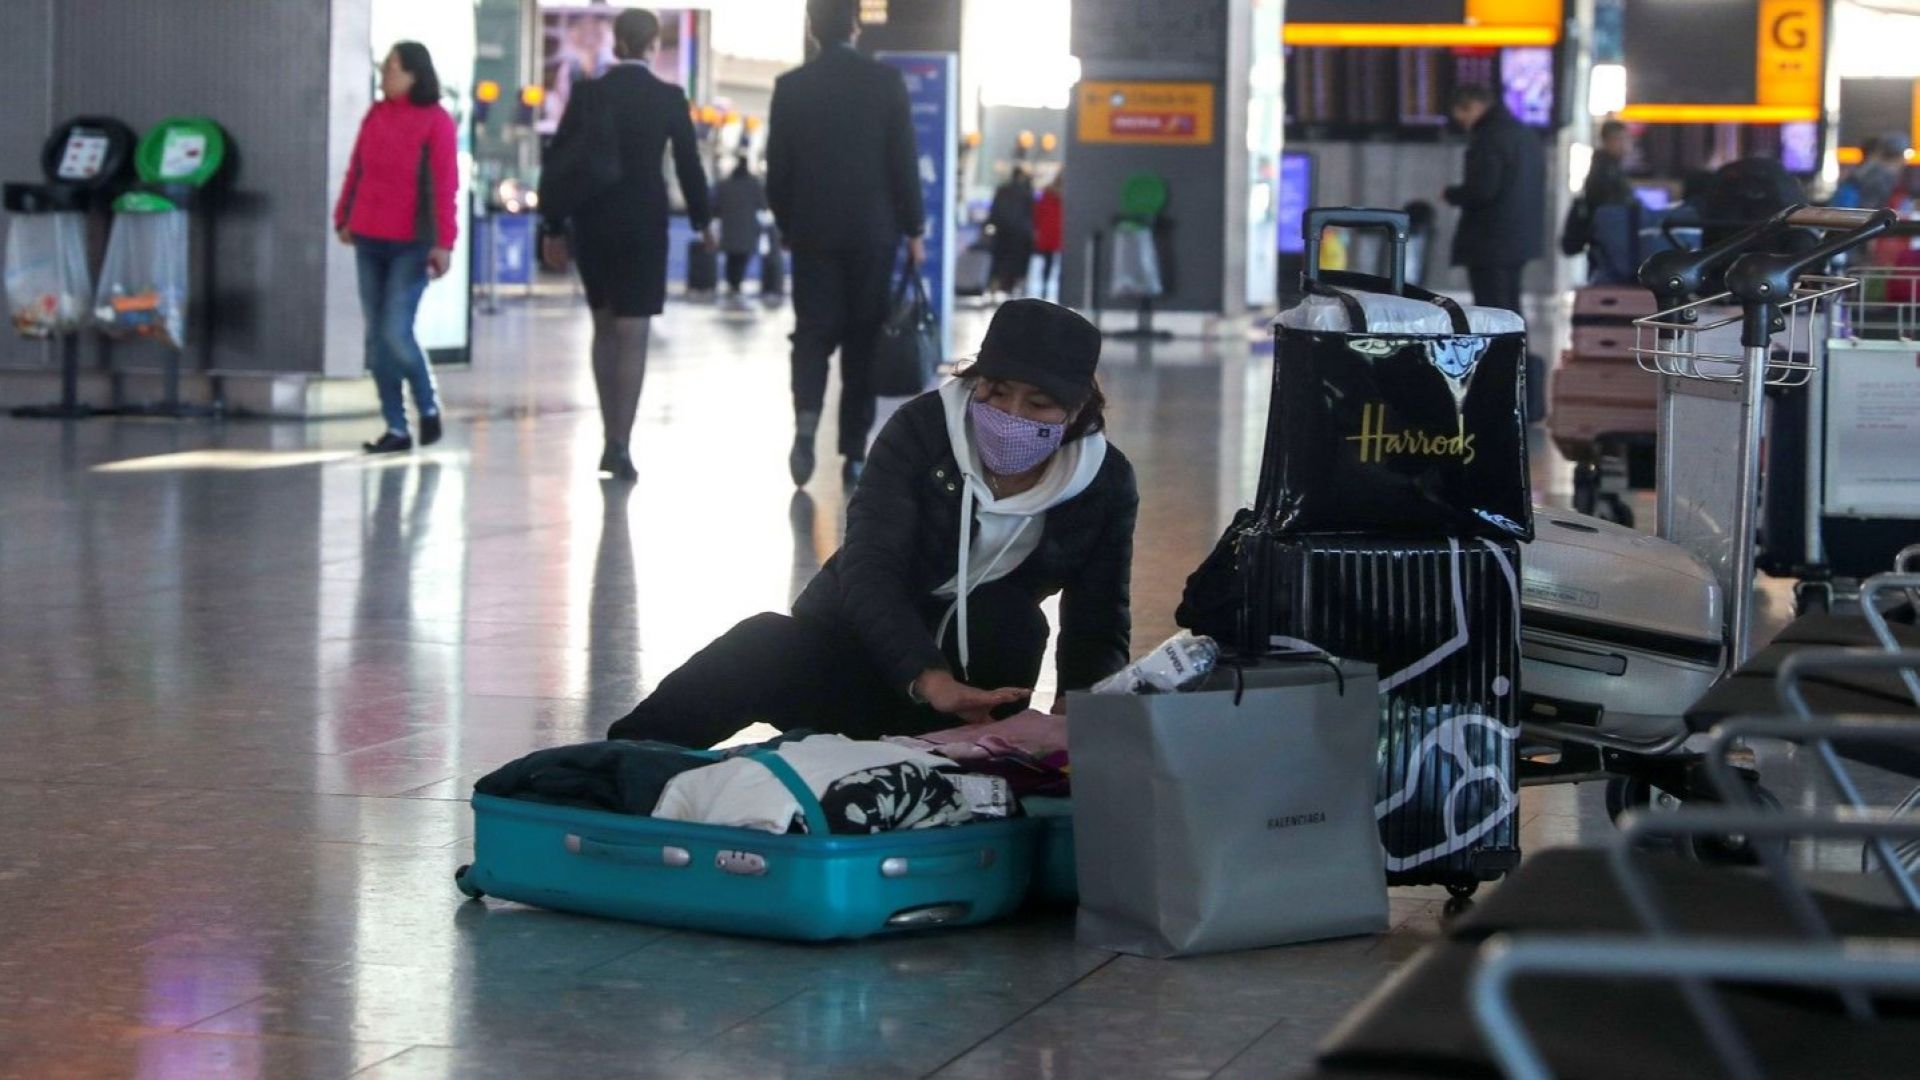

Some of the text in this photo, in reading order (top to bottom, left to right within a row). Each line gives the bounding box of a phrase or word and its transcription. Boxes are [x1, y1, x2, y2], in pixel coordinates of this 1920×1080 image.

[1772, 9, 1807, 51] G
[1345, 402, 1475, 465] Harrods
[1267, 811, 1326, 830] BALENCIAGA
